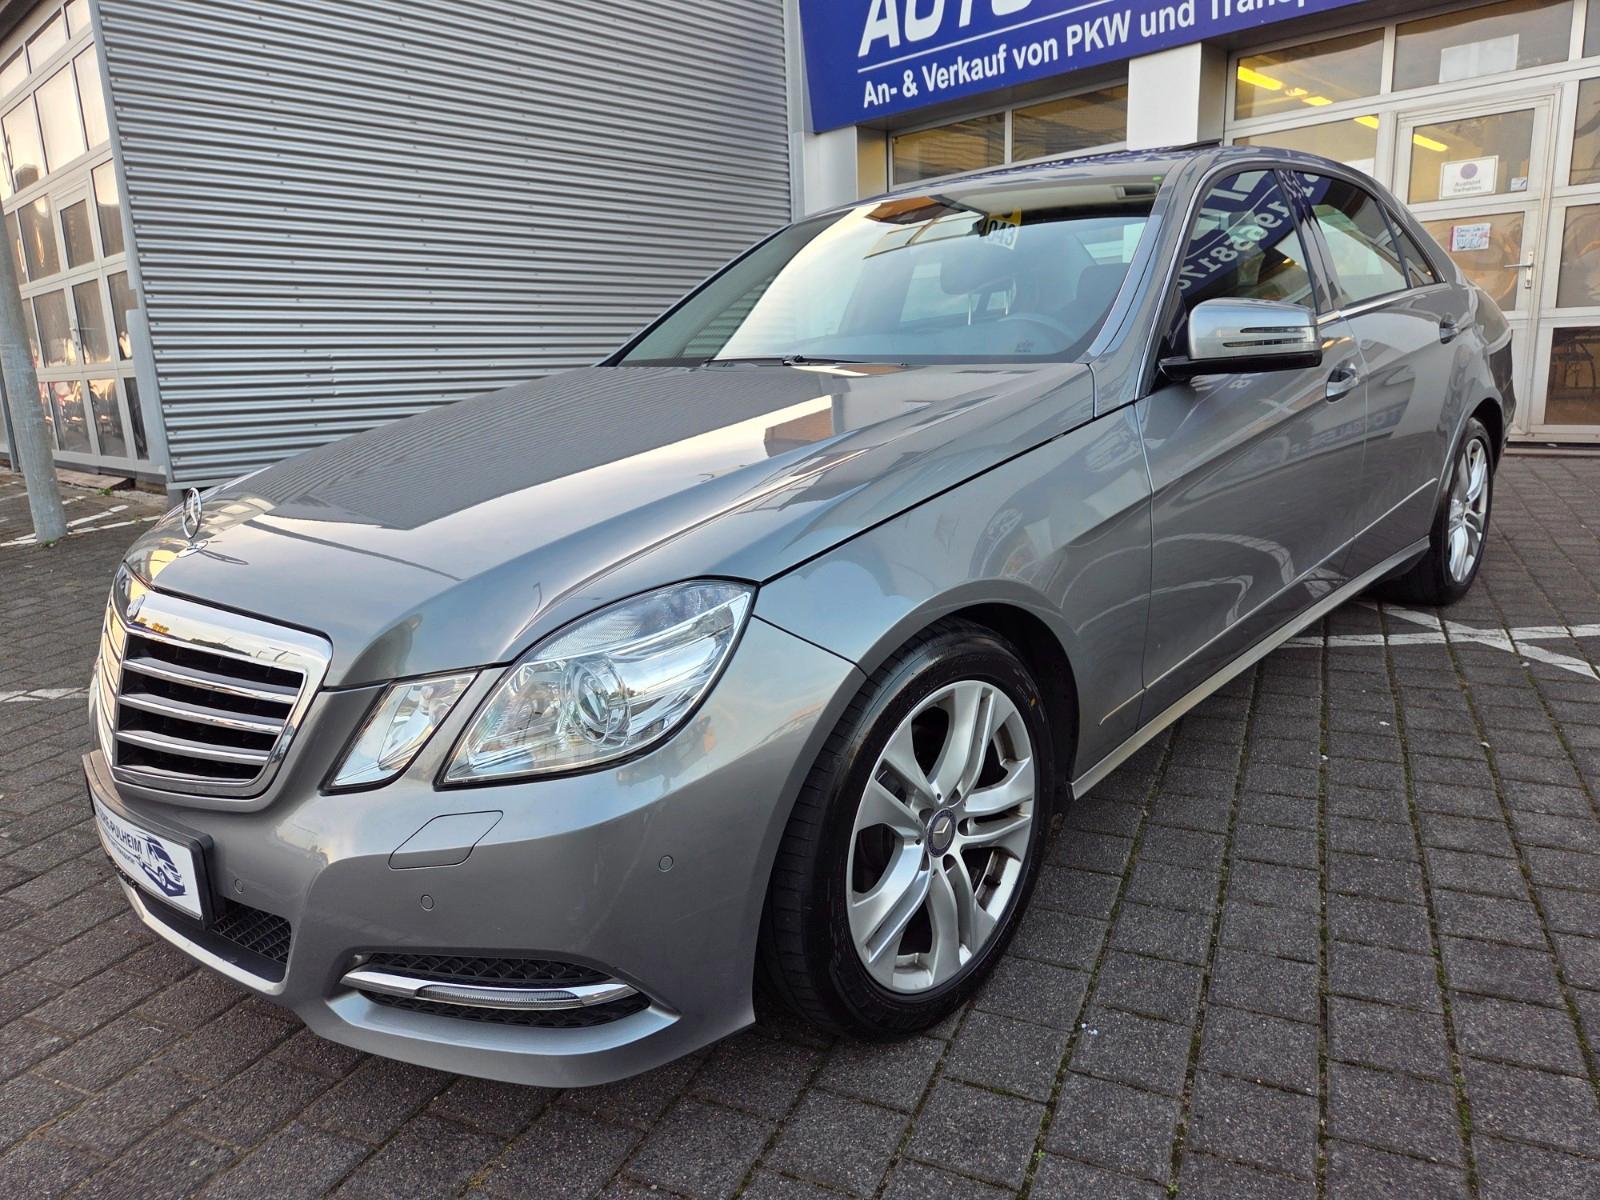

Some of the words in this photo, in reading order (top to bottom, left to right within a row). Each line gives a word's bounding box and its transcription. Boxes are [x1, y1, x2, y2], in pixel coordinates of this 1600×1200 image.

[858, 0, 1033, 57] AU
[863, 80, 898, 109] An-
[902, 69, 919, 98] &
[921, 43, 1007, 92] Verkauf
[1012, 38, 1059, 70] von
[1066, 9, 1132, 57] PKW
[1140, 0, 1196, 38] und
